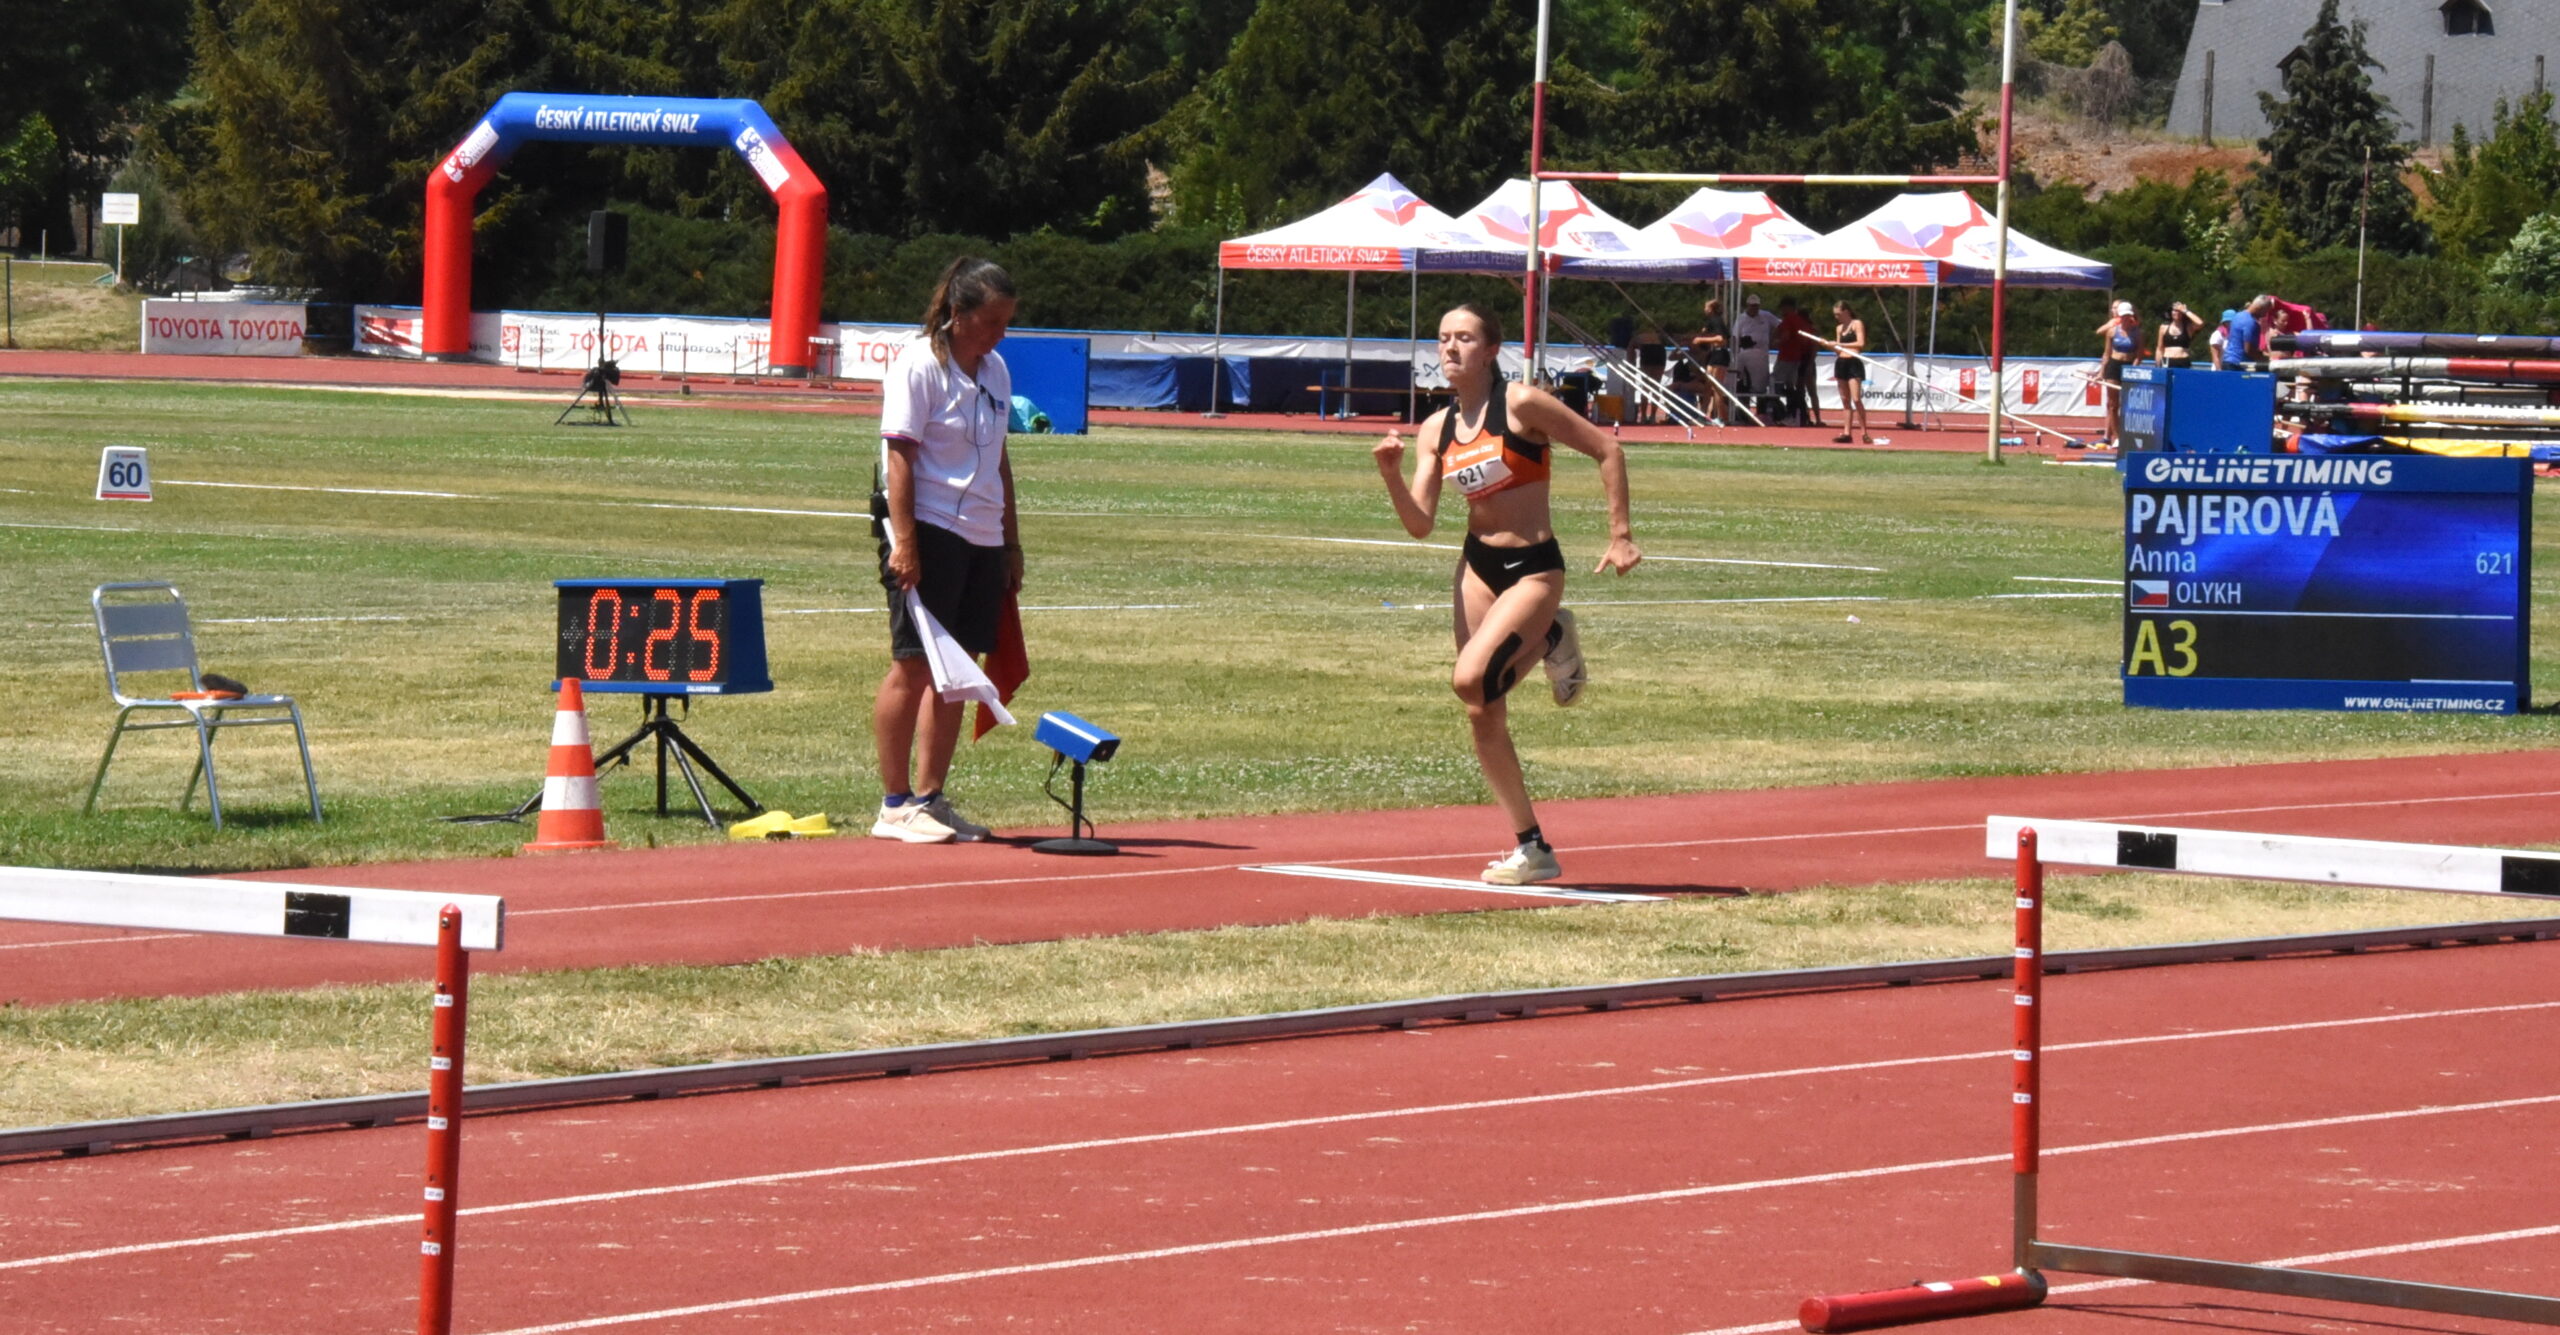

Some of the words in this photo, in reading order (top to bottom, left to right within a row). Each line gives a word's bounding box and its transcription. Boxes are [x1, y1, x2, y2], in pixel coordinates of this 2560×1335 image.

[535, 104, 584, 129] ČESKÝ
[584, 108, 662, 132] ATLETICKÝ
[662, 112, 700, 133] SVAZ
[1246, 244, 1288, 263] ČESKÝ
[1288, 245, 1354, 263] ATLETICKÝ
[1765, 257, 1807, 277] ČESKÝ
[1808, 259, 1875, 278] ATLETICKÝ
[1878, 263, 1911, 279] SVAZ
[148, 317, 224, 339] TOYOTA
[229, 319, 304, 341] TOYOTA
[569, 332, 648, 352] TOYOTA
[857, 341, 904, 363] TOY
[109, 461, 143, 488] 60
[1457, 464, 1485, 486] 621
[2145, 458, 2393, 485] ONLINETIMING
[2131, 491, 2340, 545] PAJEROVÁ
[2129, 544, 2197, 573] Anna
[2475, 552, 2513, 575] 621
[2176, 582, 2241, 604] OLYKH
[585, 589, 720, 681] 0:25
[2127, 619, 2198, 677] A3
[2344, 696, 2505, 711] WWW.ONLINETIMING.CZ
